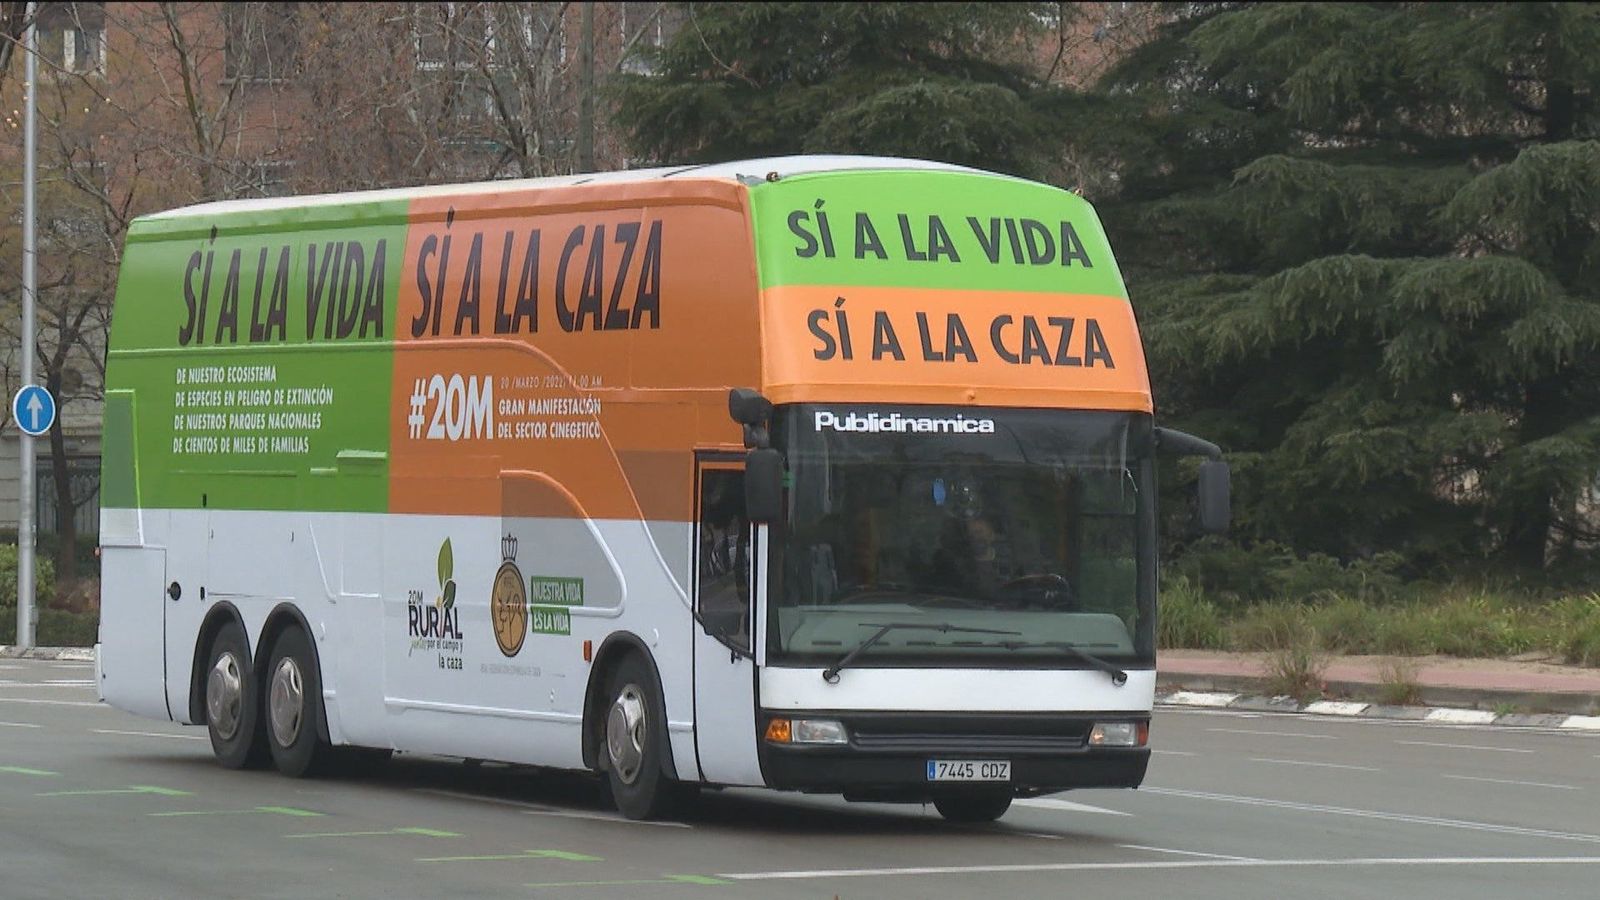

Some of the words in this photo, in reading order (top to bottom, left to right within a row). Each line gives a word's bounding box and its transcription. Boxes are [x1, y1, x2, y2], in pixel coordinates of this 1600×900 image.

[787, 198, 836, 259] SÍ
[854, 211, 889, 260] A
[897, 213, 961, 263] LA
[965, 216, 1093, 268] VIDA
[411, 206, 453, 338] SÍ
[453, 232, 483, 336] A
[494, 229, 541, 334] LA
[555, 219, 662, 333] CAZA
[178, 224, 215, 346] SÍ
[214, 248, 241, 344] A
[250, 245, 290, 342] LA
[306, 238, 387, 341] VIDA
[806, 296, 853, 361] SÍ
[871, 311, 905, 361] A
[915, 311, 978, 363] LA
[989, 314, 1115, 369] CAZA
[176, 368, 186, 384] DE
[188, 367, 225, 383] NUESTRO
[227, 365, 277, 382] ECOSISTEMA
[175, 391, 185, 407] DE
[187, 390, 222, 406] ESPECIES
[224, 389, 235, 406] EN
[237, 388, 272, 406] PELIGRO
[274, 388, 285, 405] DE
[287, 383, 333, 405] EXTINCIÓN
[408, 373, 494, 441] #20M
[498, 399, 525, 416] GRAN
[174, 414, 184, 430] DE
[186, 413, 227, 430] NUESTROS
[229, 413, 266, 430] PARQUES
[268, 412, 321, 429] NACIONALES
[498, 422, 513, 439] DEL
[515, 422, 548, 439] SECTOR
[814, 410, 995, 434] Publidinamica
[173, 437, 183, 453] DE
[185, 437, 218, 453] CIENTOS
[220, 437, 231, 453] DE
[233, 436, 256, 453] MILES
[258, 436, 269, 453] DE
[271, 436, 309, 453] FAMILIAS
[533, 581, 565, 600] NUESTRA
[565, 583, 582, 600] VIDA
[552, 613, 569, 631] VIDA
[939, 763, 974, 778] 7445
[981, 763, 1008, 778] CDZ
